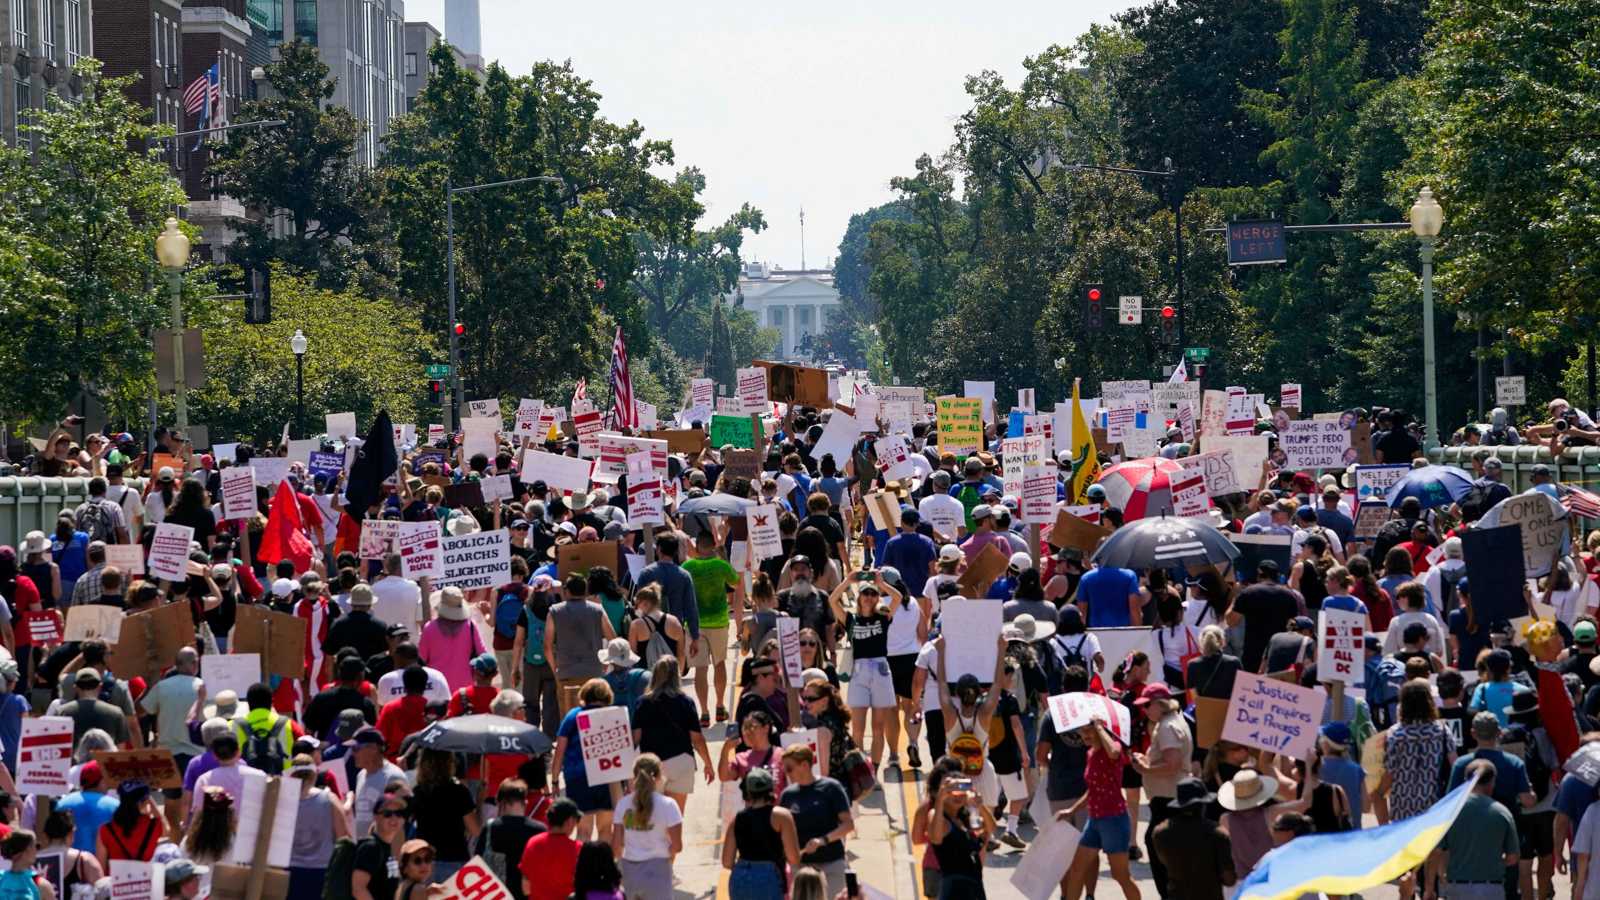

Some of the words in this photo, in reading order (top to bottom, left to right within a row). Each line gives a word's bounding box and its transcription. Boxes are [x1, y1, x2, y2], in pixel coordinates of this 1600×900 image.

[1232, 226, 1280, 241] MERGE
[1240, 242, 1275, 256] LEFT
[892, 391, 920, 401] Process
[471, 402, 487, 411] END
[941, 423, 953, 432] WE
[968, 423, 981, 432] ALL
[1291, 423, 1319, 432] SHAME
[1324, 423, 1338, 432] ON
[1285, 434, 1319, 443] TRUMP'S
[1322, 434, 1344, 443] PEDO
[1002, 439, 1041, 453] TRUMP
[1287, 445, 1342, 455] PROTECTION
[1004, 454, 1038, 464] WANTED
[1298, 456, 1333, 466] SQUAD
[1006, 466, 1021, 474] FOR
[1359, 471, 1382, 480] MELT
[1386, 470, 1401, 478] ICE
[1371, 478, 1393, 487] FREE
[400, 529, 438, 547] PROTECT
[1537, 530, 1557, 547] US
[406, 554, 434, 565] HOME
[409, 562, 433, 572] RULE
[1334, 650, 1353, 662] ALL
[1336, 663, 1350, 675] DC
[1253, 679, 1299, 704] Justice
[1247, 699, 1264, 710] all
[1271, 704, 1312, 723] requires
[1236, 708, 1259, 724] Due
[1263, 713, 1301, 737] Process
[584, 725, 628, 747] TODOS
[499, 736, 521, 750] DC
[585, 737, 630, 761] SOMOS
[32, 748, 62, 761] END
[599, 755, 622, 771] DC
[27, 770, 63, 778] FEDERAL
